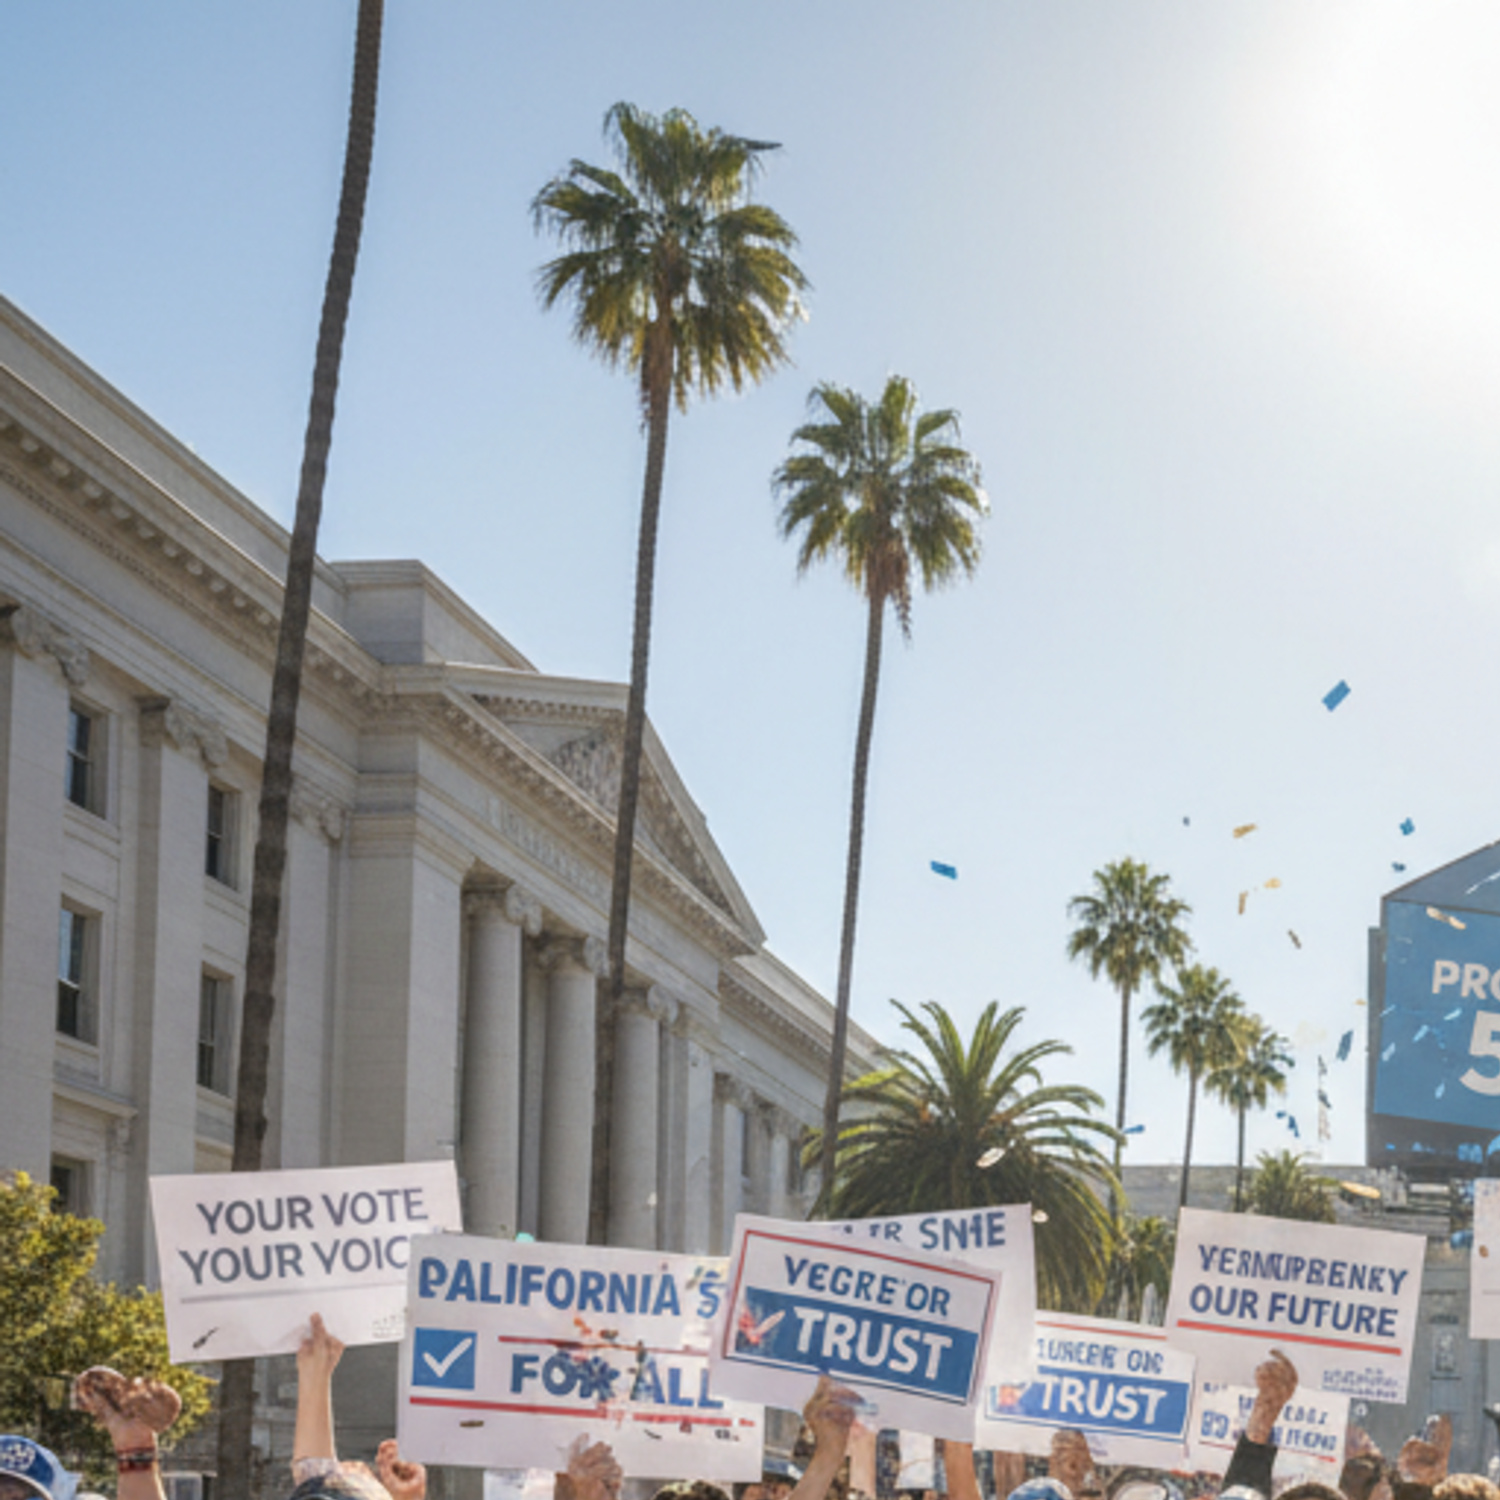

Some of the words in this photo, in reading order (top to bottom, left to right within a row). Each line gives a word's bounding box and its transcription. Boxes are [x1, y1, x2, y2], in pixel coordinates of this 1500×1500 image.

[196, 1195, 315, 1236] YOUR
[321, 1187, 429, 1227] VOTE
[176, 1242, 305, 1286] YOUR
[1189, 1283, 1259, 1320] OUR
[1267, 1291, 1399, 1338] FUTURE
[793, 1305, 953, 1380] TRUST
[1038, 1374, 1168, 1425] TRUST
